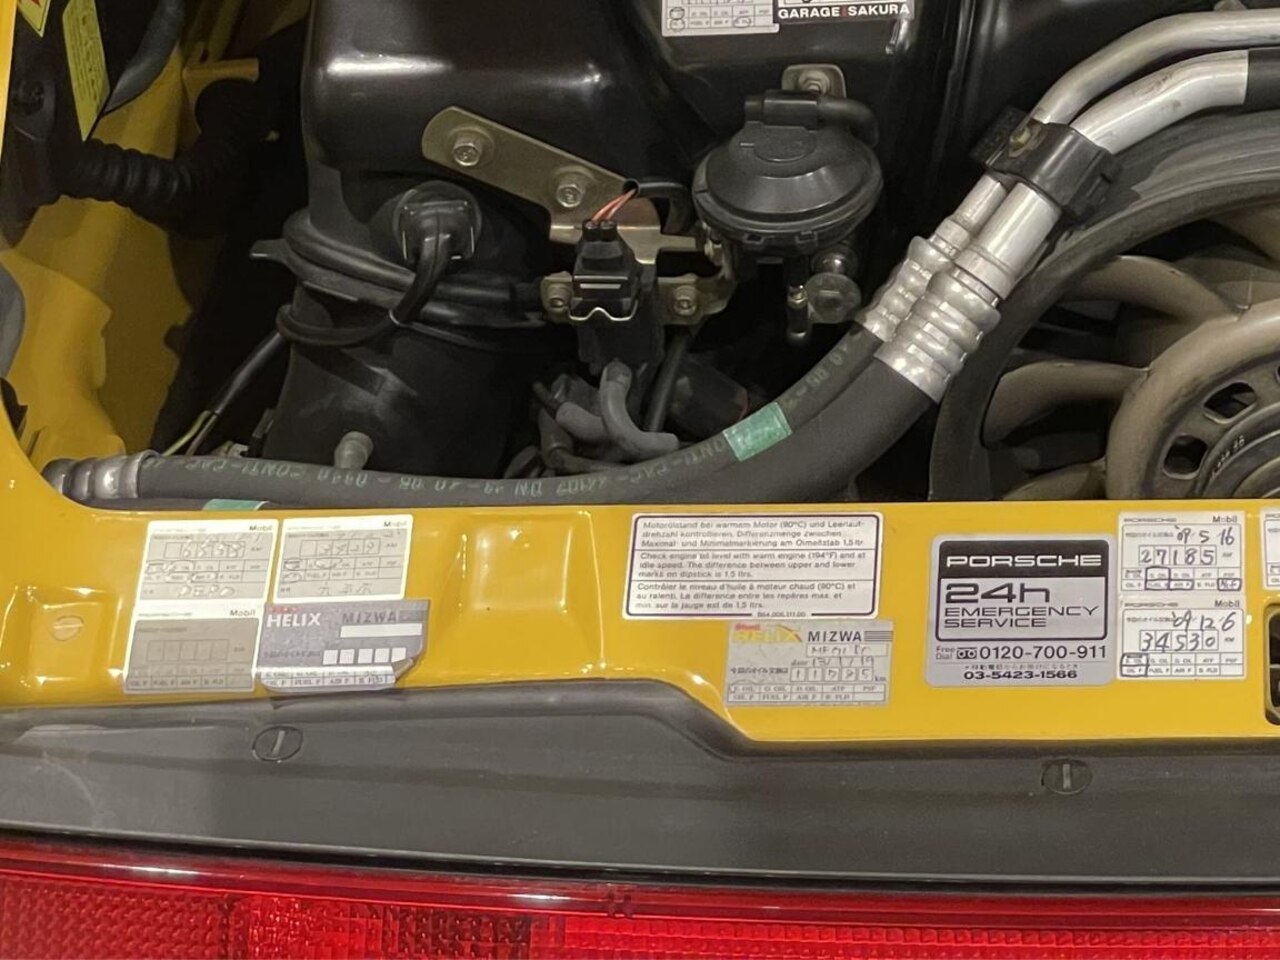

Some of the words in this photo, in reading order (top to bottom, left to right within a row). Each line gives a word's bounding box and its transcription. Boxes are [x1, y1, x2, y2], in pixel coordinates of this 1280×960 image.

[779, 7, 840, 19] GARAGE
[848, 4, 910, 16] SAKURA
[1199, 530, 1210, 543] 5
[1220, 526, 1235, 546] 16
[669, 552, 697, 560] engine
[778, 552, 805, 560] engine
[946, 554, 1102, 567] PORSCHE
[1141, 548, 1215, 566] 27185
[788, 562, 812, 570] upper
[789, 582, 815, 590] chaud
[738, 592, 760, 600] entre
[945, 583, 1050, 603] 24h
[681, 602, 704, 610] jauge
[944, 606, 1099, 617] EMERGENCY
[229, 609, 256, 617] Mobil
[341, 610, 398, 624] MIZWA
[267, 612, 322, 628] HELIX
[943, 618, 1047, 628] SERVICE
[1221, 611, 1237, 631] 6
[808, 631, 862, 642] MIZWA
[1140, 632, 1216, 653] 34530
[936, 652, 953, 660] Dial
[979, 645, 1106, 660] 0120-700-911
[964, 670, 1078, 680] 03-5423-1566
